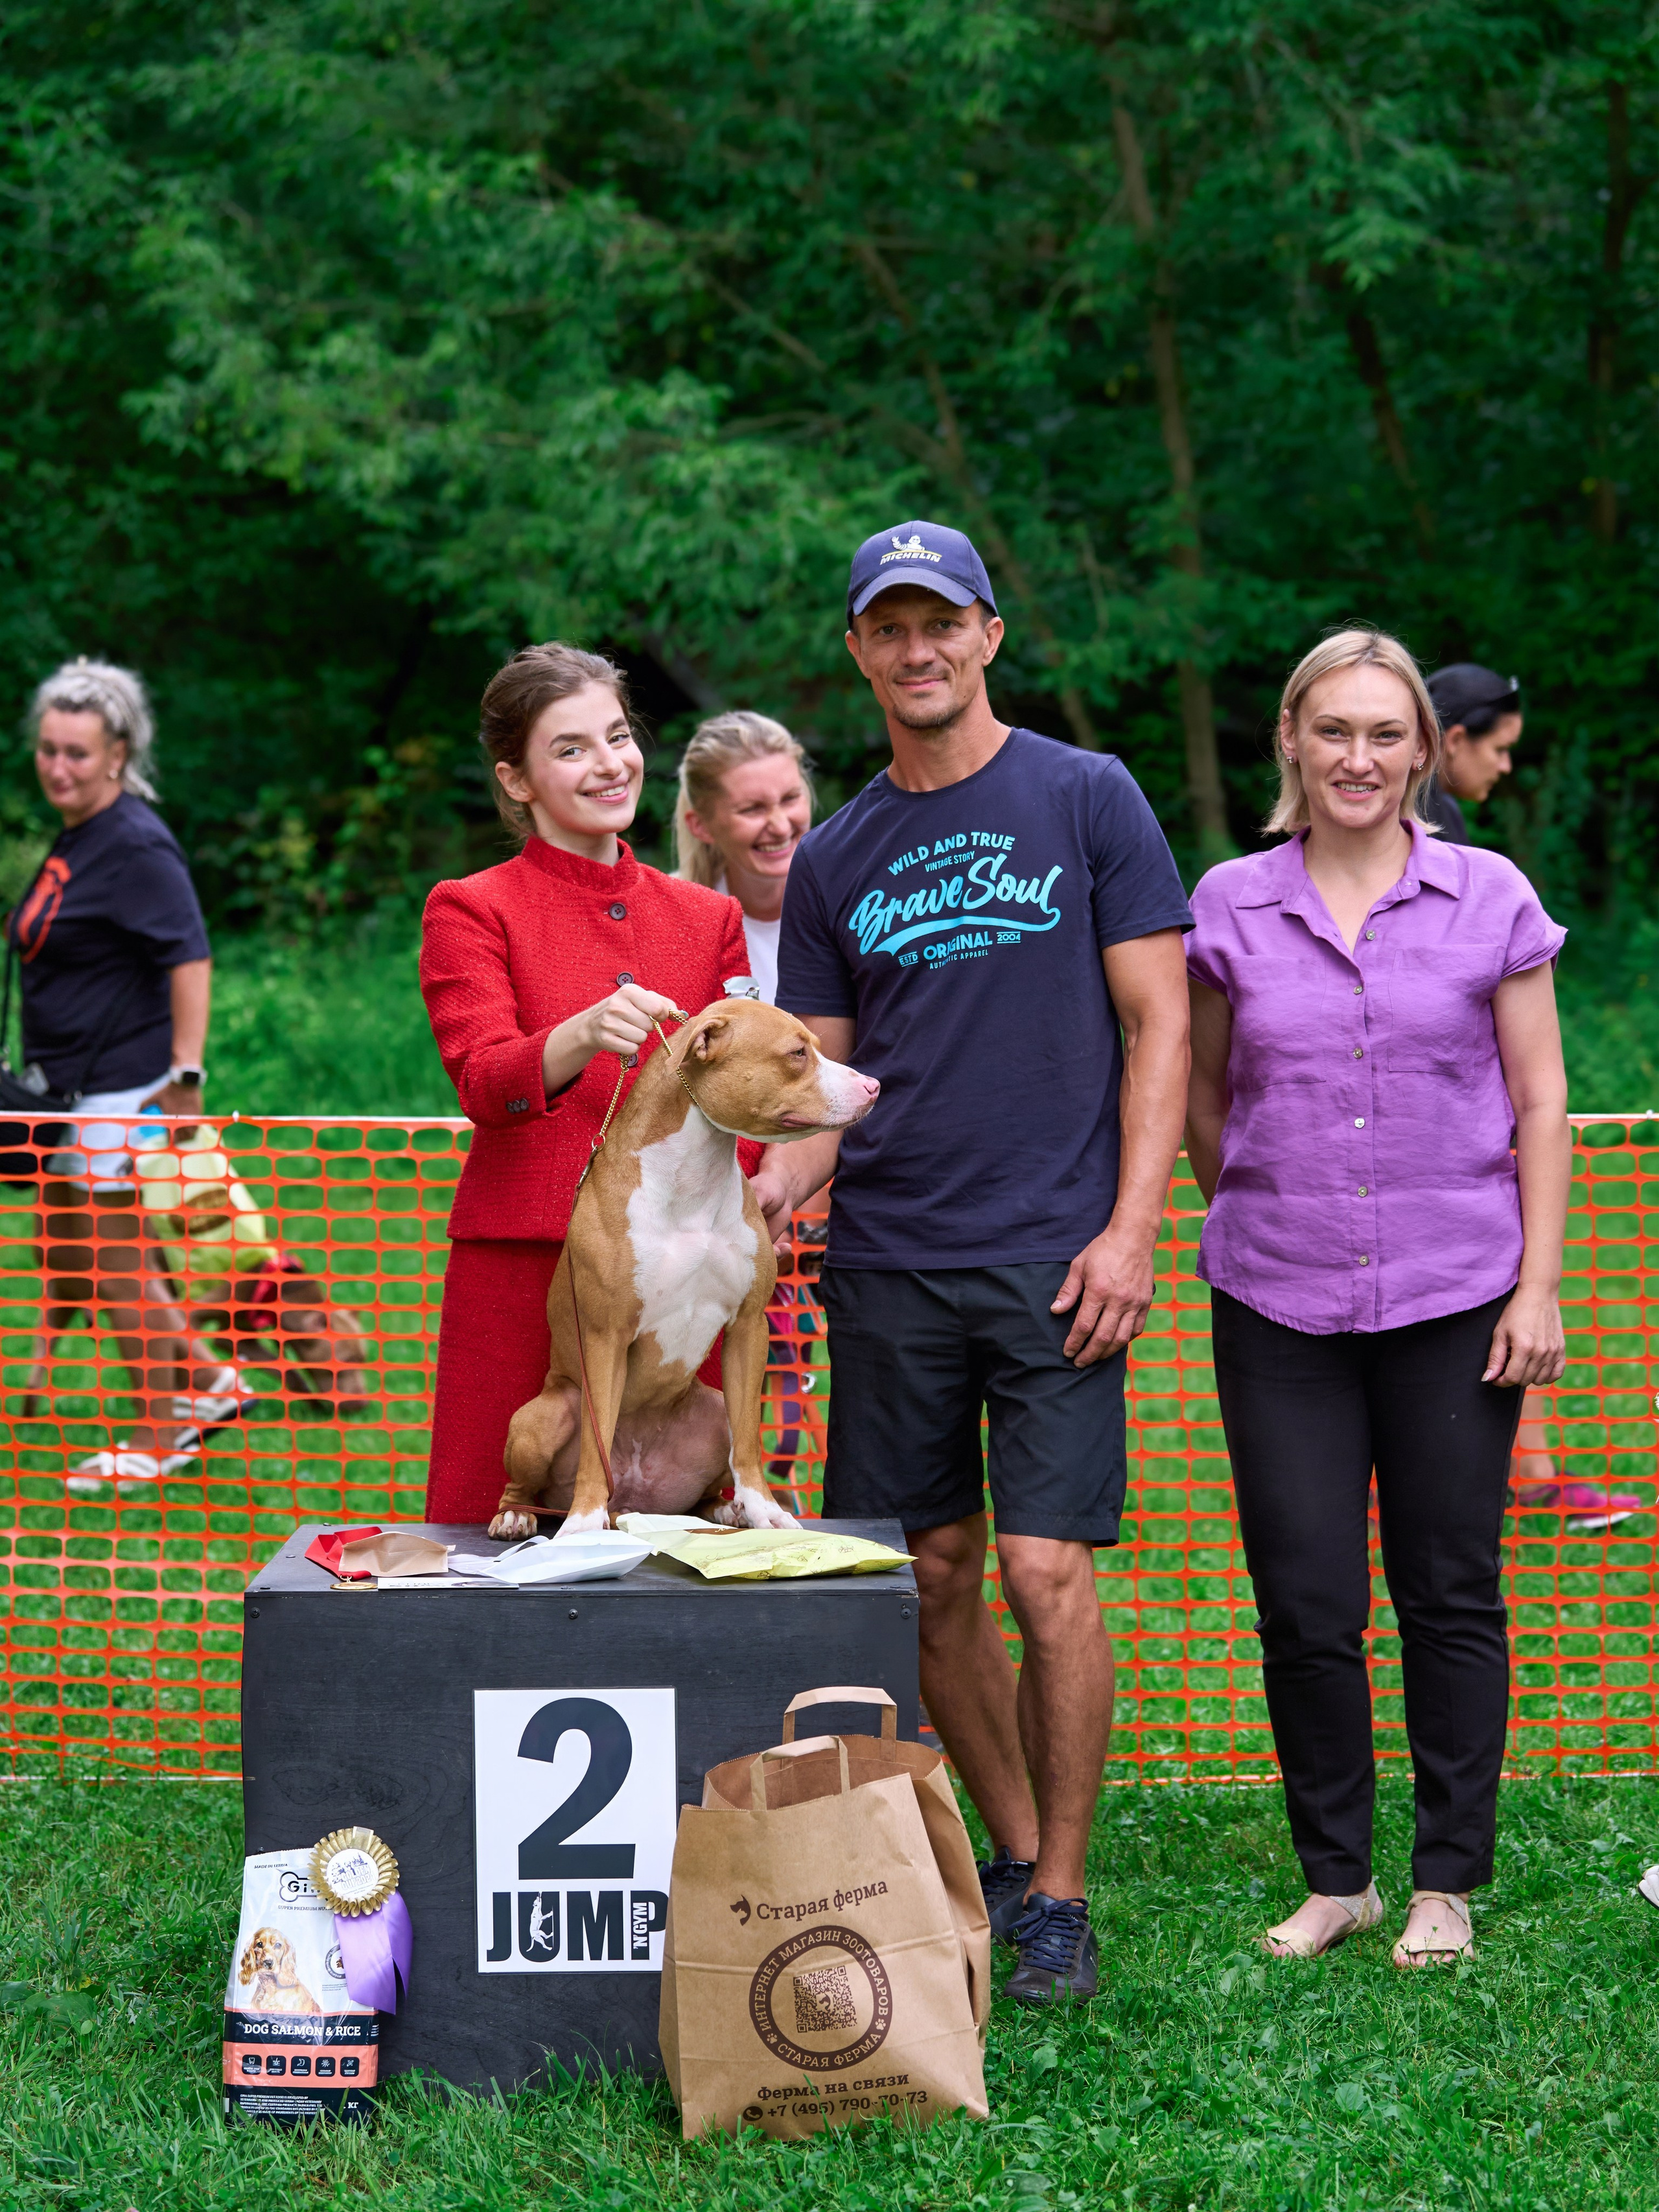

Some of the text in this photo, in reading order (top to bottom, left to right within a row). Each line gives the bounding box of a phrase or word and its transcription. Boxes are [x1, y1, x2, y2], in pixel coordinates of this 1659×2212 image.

[879, 552, 940, 565] MICHELIN
[887, 832, 1015, 876] WILD AND TRUE
[925, 850, 975, 872] VINTAGE STORY
[899, 953, 918, 965] ESTD
[923, 931, 993, 960] ORIGINAL
[960, 949, 988, 960] APPAREL
[516, 1697, 636, 1880] 2
[756, 1881, 888, 1922] Старая ферма
[486, 1890, 669, 1962] JUMP
[754, 1930, 888, 2032] ИНТЕРНЕТ МАГАЗИН ЗООТОВАРОВ
[244, 2023, 269, 2034] DOG
[271, 2025, 323, 2036] SALMON
[325, 2027, 332, 2036] &
[334, 2026, 361, 2036] RICE
[778, 2033, 881, 2067] СТАРАЯ ФЕРМА
[758, 2074, 909, 2101] Ферма на связи
[767, 2091, 927, 2117] +7 (495) 790-70-73
